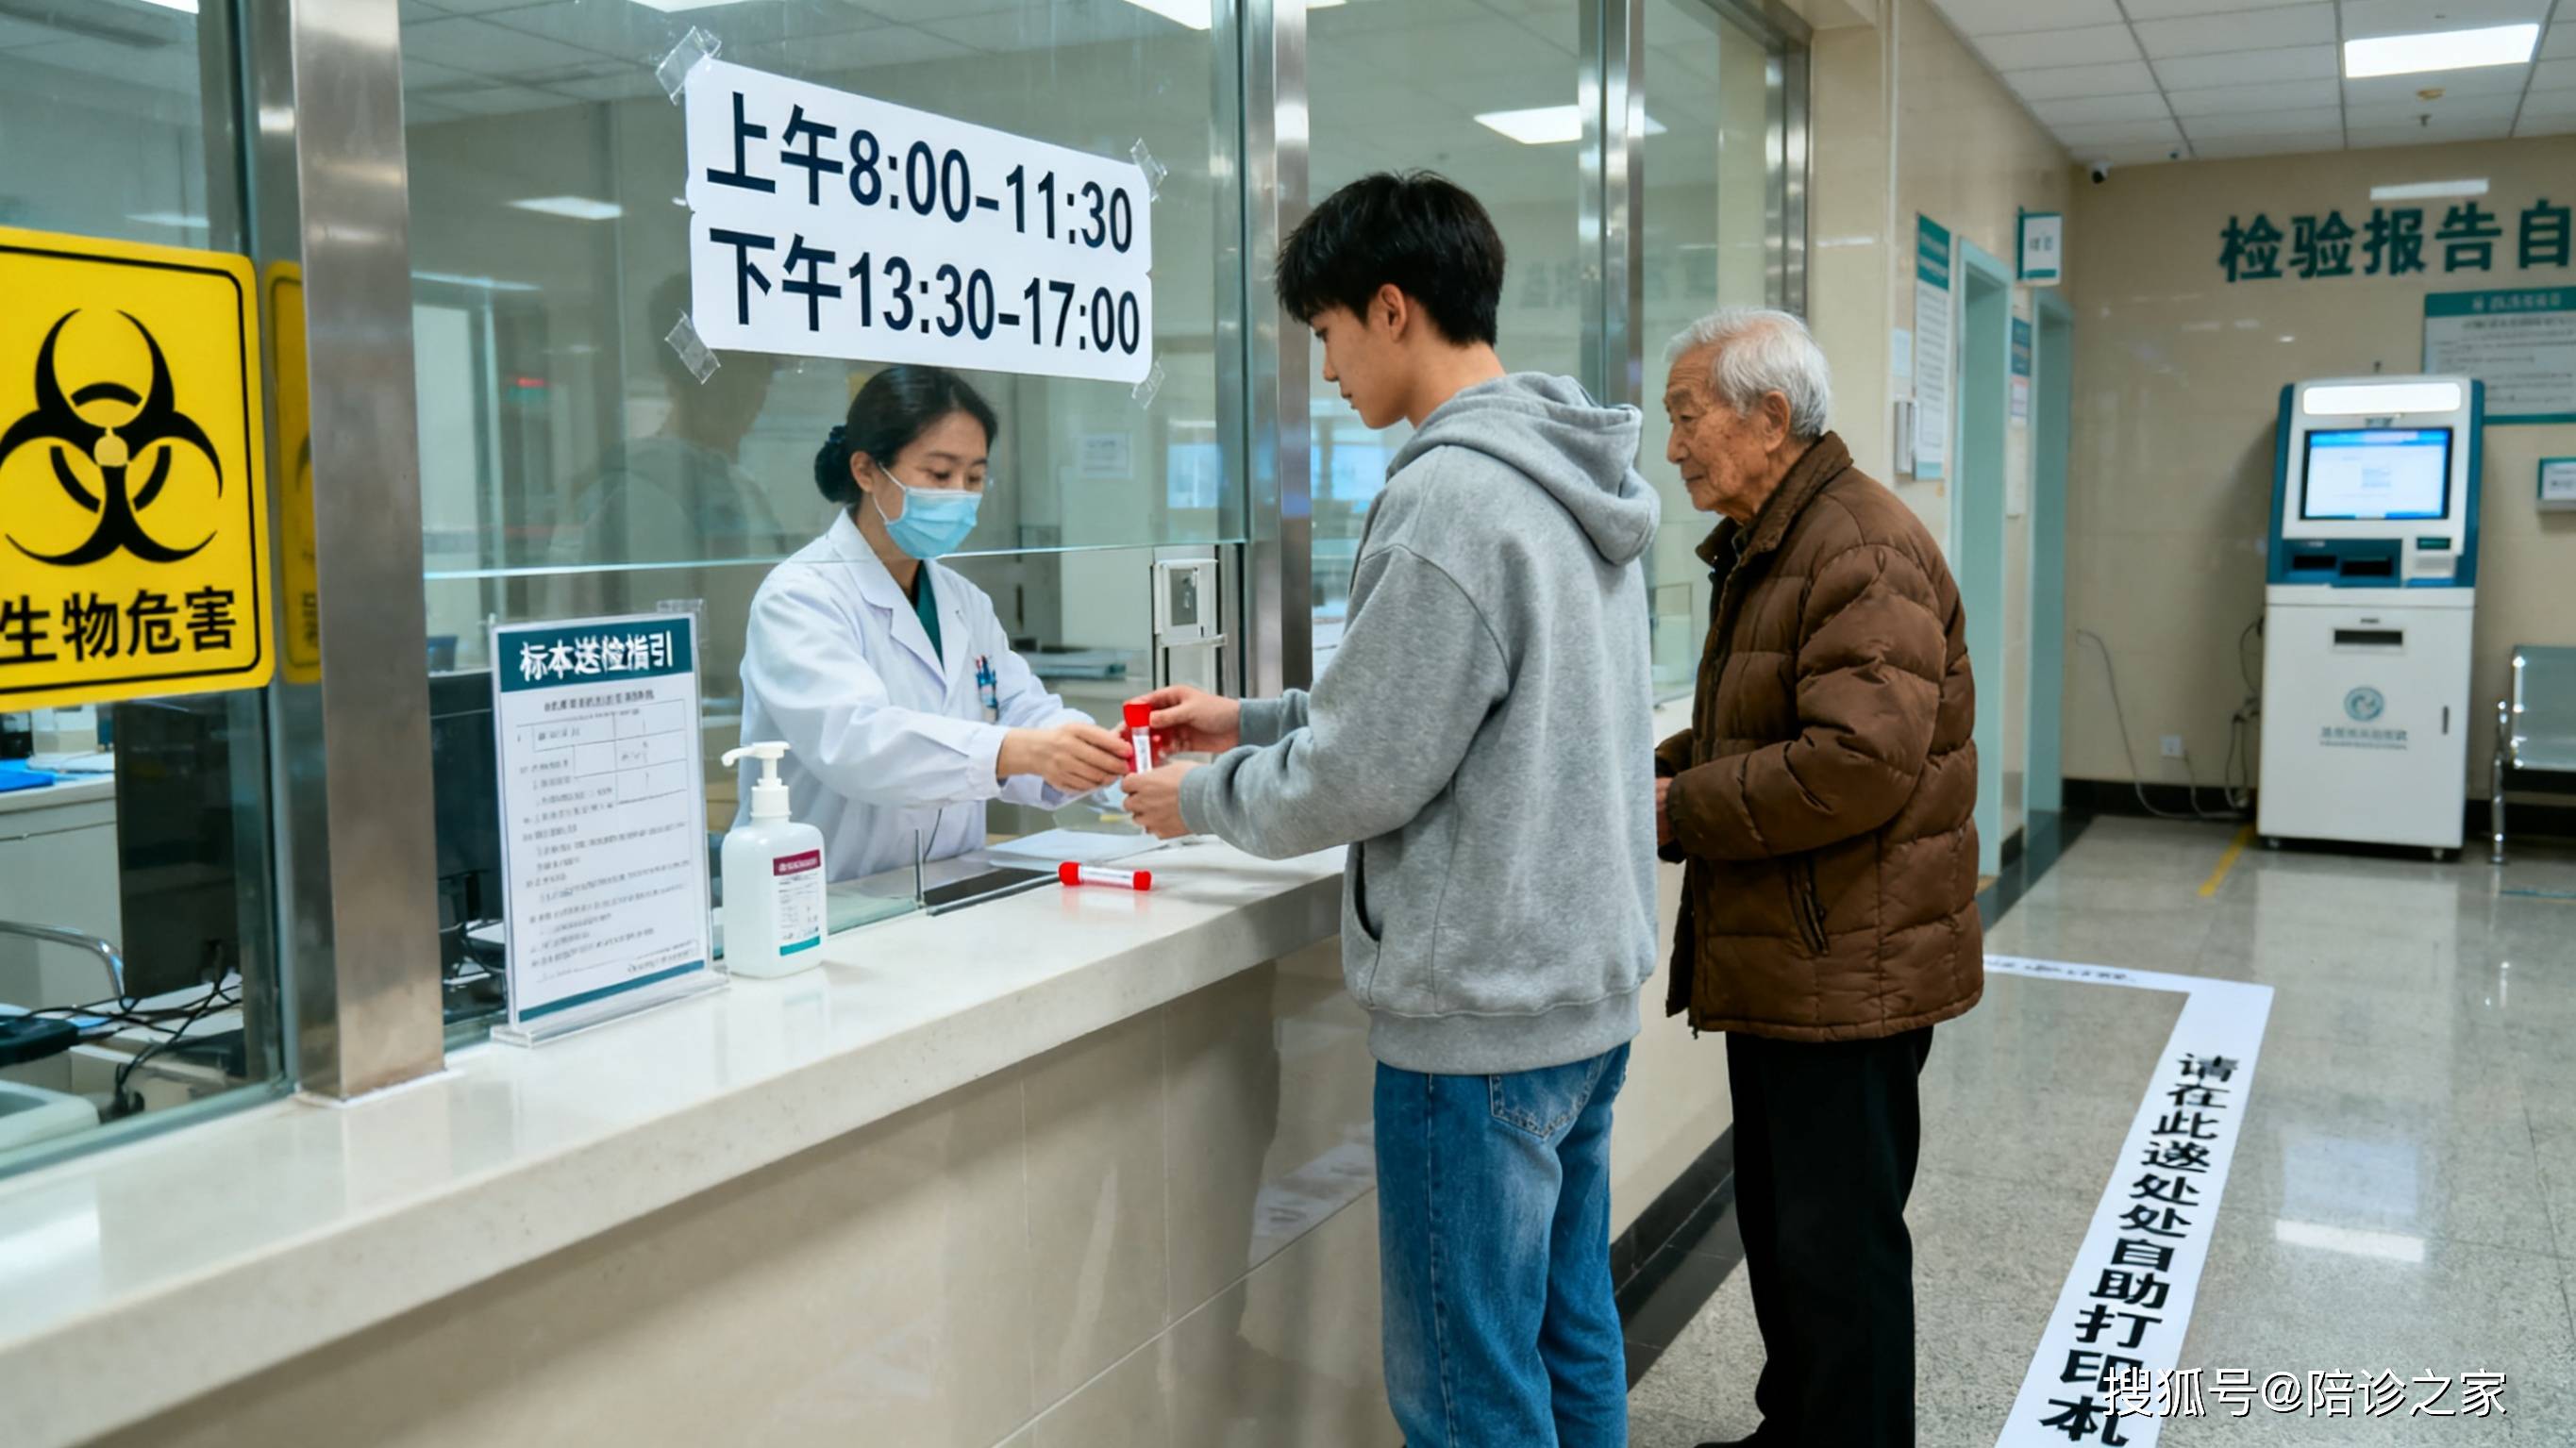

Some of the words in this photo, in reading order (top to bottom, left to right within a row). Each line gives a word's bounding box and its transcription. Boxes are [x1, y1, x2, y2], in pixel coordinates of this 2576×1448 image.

[706, 91, 1133, 254] 上午8:00-11:30
[708, 226, 1141, 356] 下午13:30-17:00
[2217, 198, 2571, 283] 检验报告自
[0, 585, 236, 663] 生物危害
